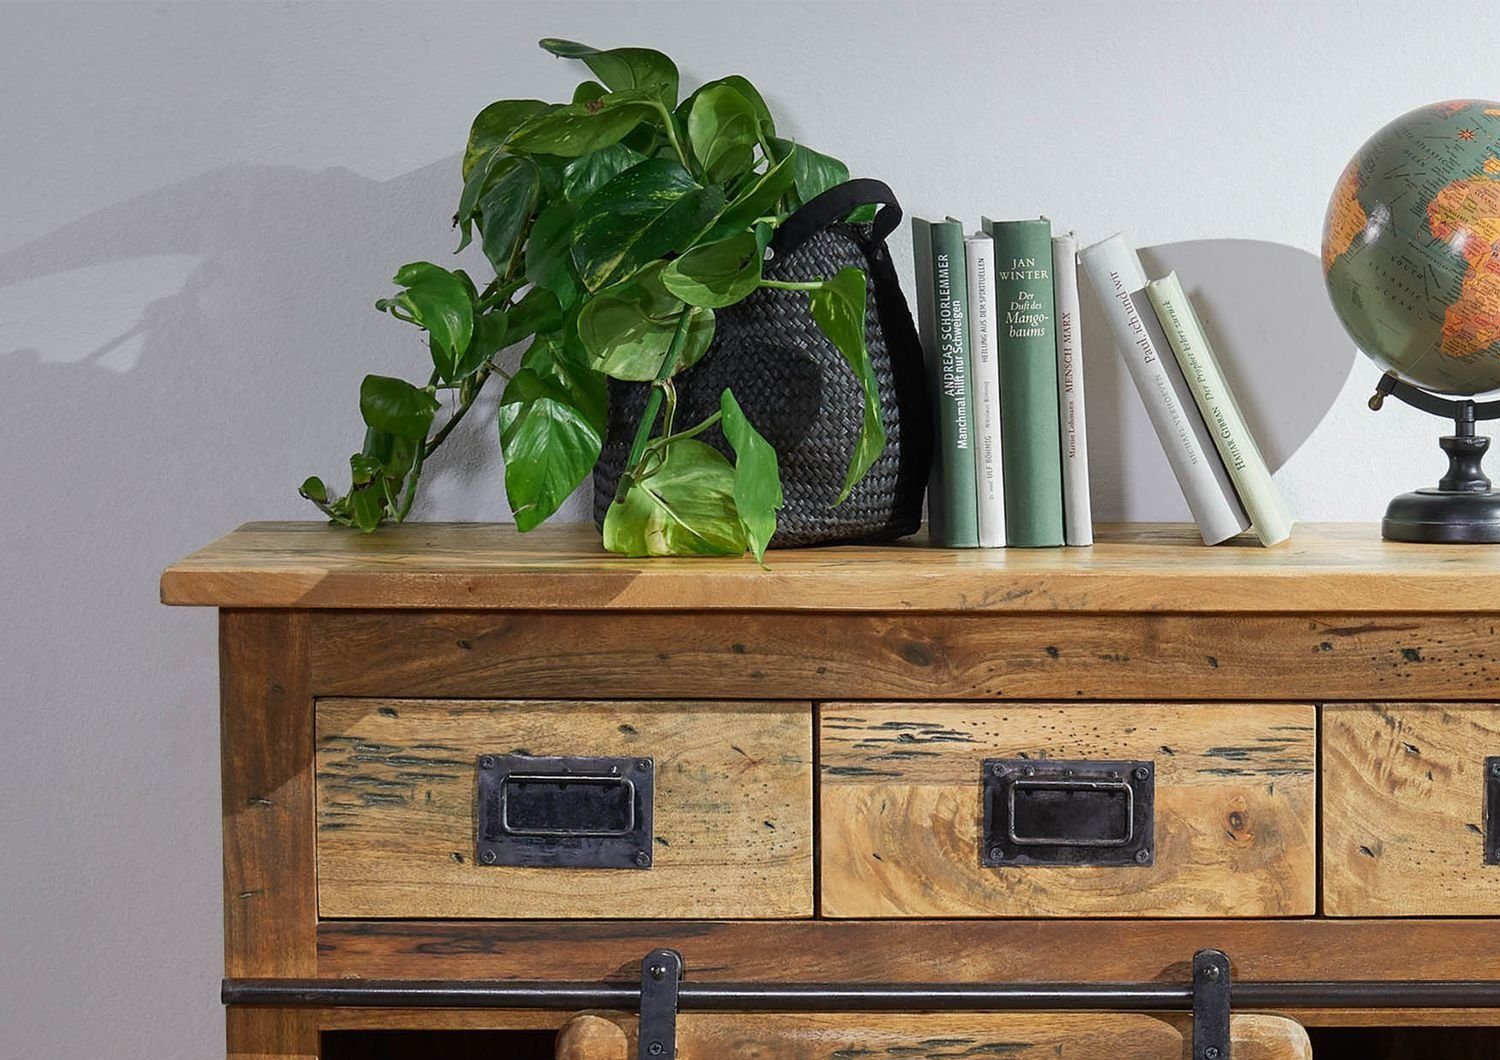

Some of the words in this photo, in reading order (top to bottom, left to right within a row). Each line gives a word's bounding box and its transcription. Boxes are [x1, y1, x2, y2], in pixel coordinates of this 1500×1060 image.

[999, 269, 1049, 281] WINTER
[1011, 257, 1036, 270] JAN
[977, 257, 986, 302] SPIRITUELLEN
[1110, 271, 1123, 288] wir
[938, 254, 953, 341] SCHORLEMMER
[1018, 291, 1034, 301] Der
[1115, 290, 1135, 316] und
[979, 304, 987, 318] DEM
[1005, 311, 1049, 327] Mango-
[1127, 310, 1142, 335] ich
[952, 300, 964, 355] Schweigen
[980, 319, 988, 334] AUS
[1009, 325, 1045, 337] baums
[1062, 312, 1071, 343] MARX
[1136, 331, 1156, 364] Paul,
[942, 343, 955, 397] ANDREAS
[955, 355, 965, 372] nur
[1064, 348, 1073, 394] MENSCH
[953, 374, 965, 395] hilft
[954, 396, 968, 449] Manchmal
